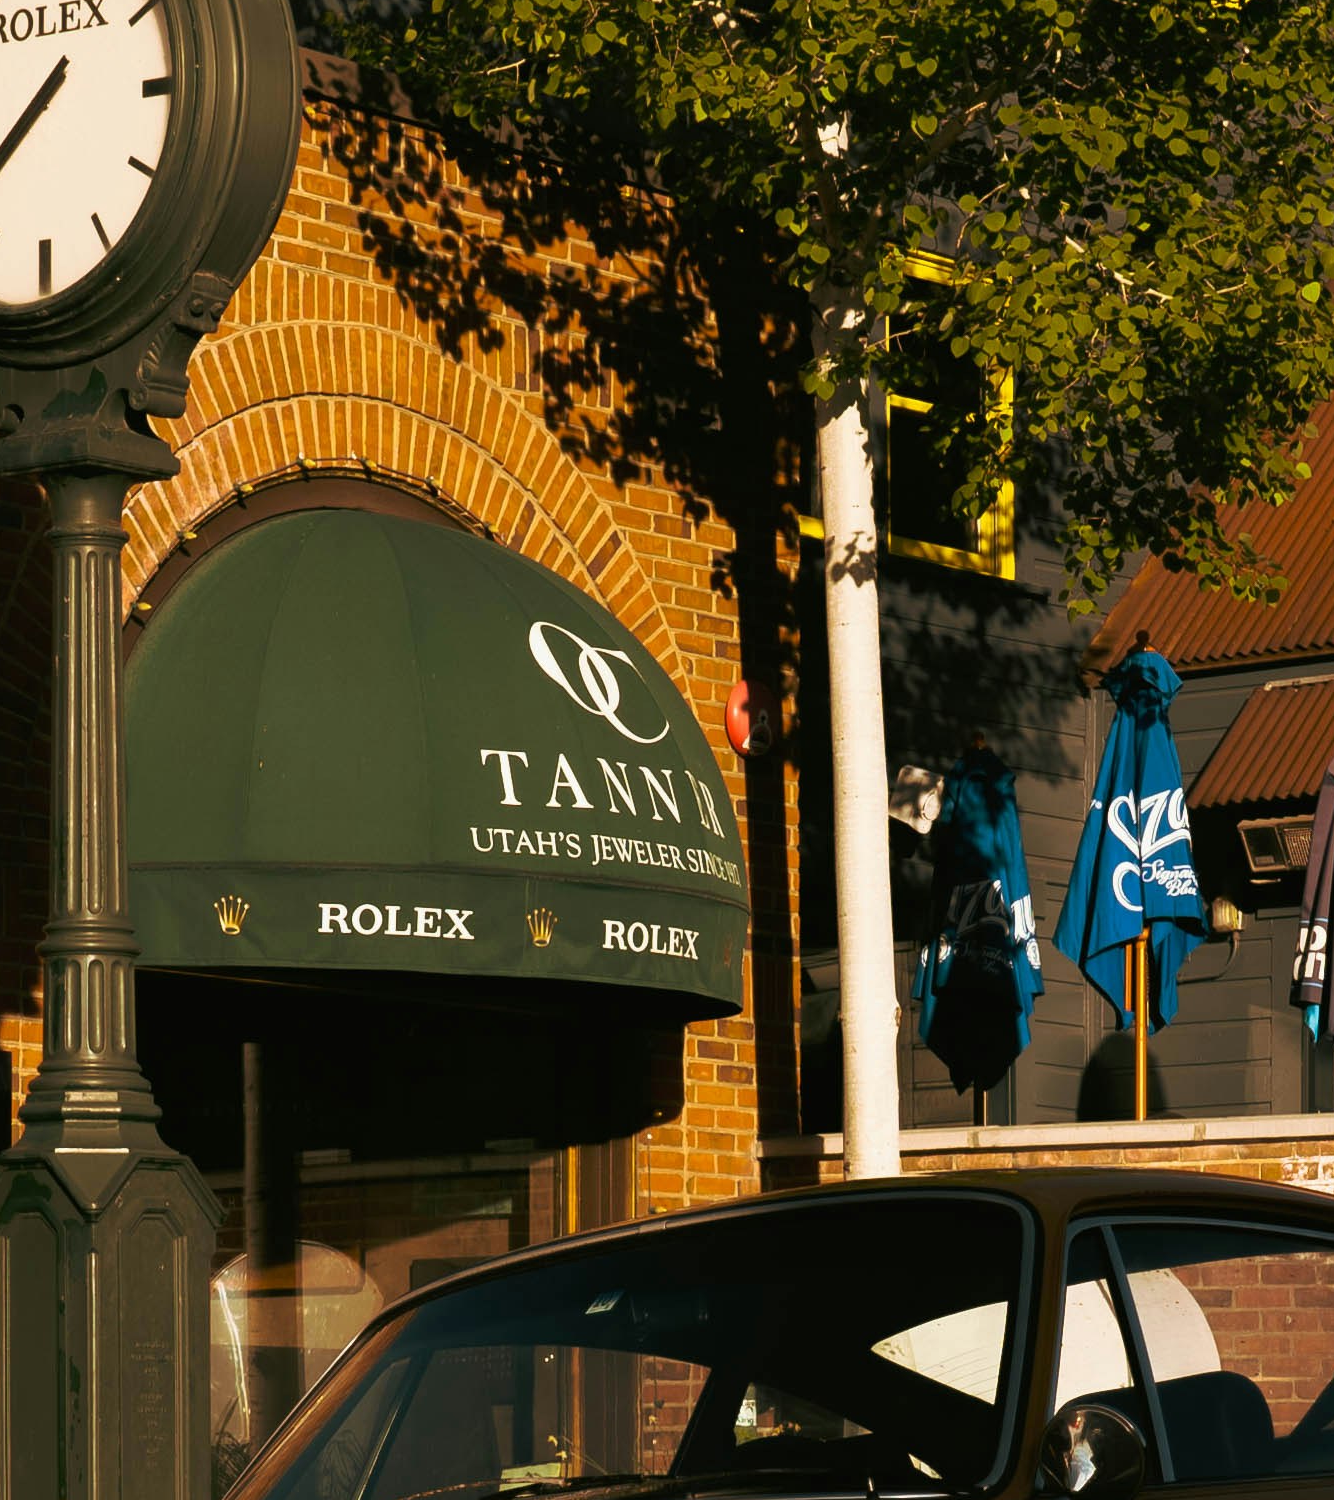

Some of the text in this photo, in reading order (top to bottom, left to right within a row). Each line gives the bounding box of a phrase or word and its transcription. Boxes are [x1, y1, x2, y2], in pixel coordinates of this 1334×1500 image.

[470, 827, 582, 859] UTAH'S
[590, 834, 687, 871] JEWELER
[685, 848, 728, 882] SINCE
[1166, 880, 1198, 896] Blu
[317, 903, 475, 940] ROLEX
[602, 919, 700, 960] ROLEX
